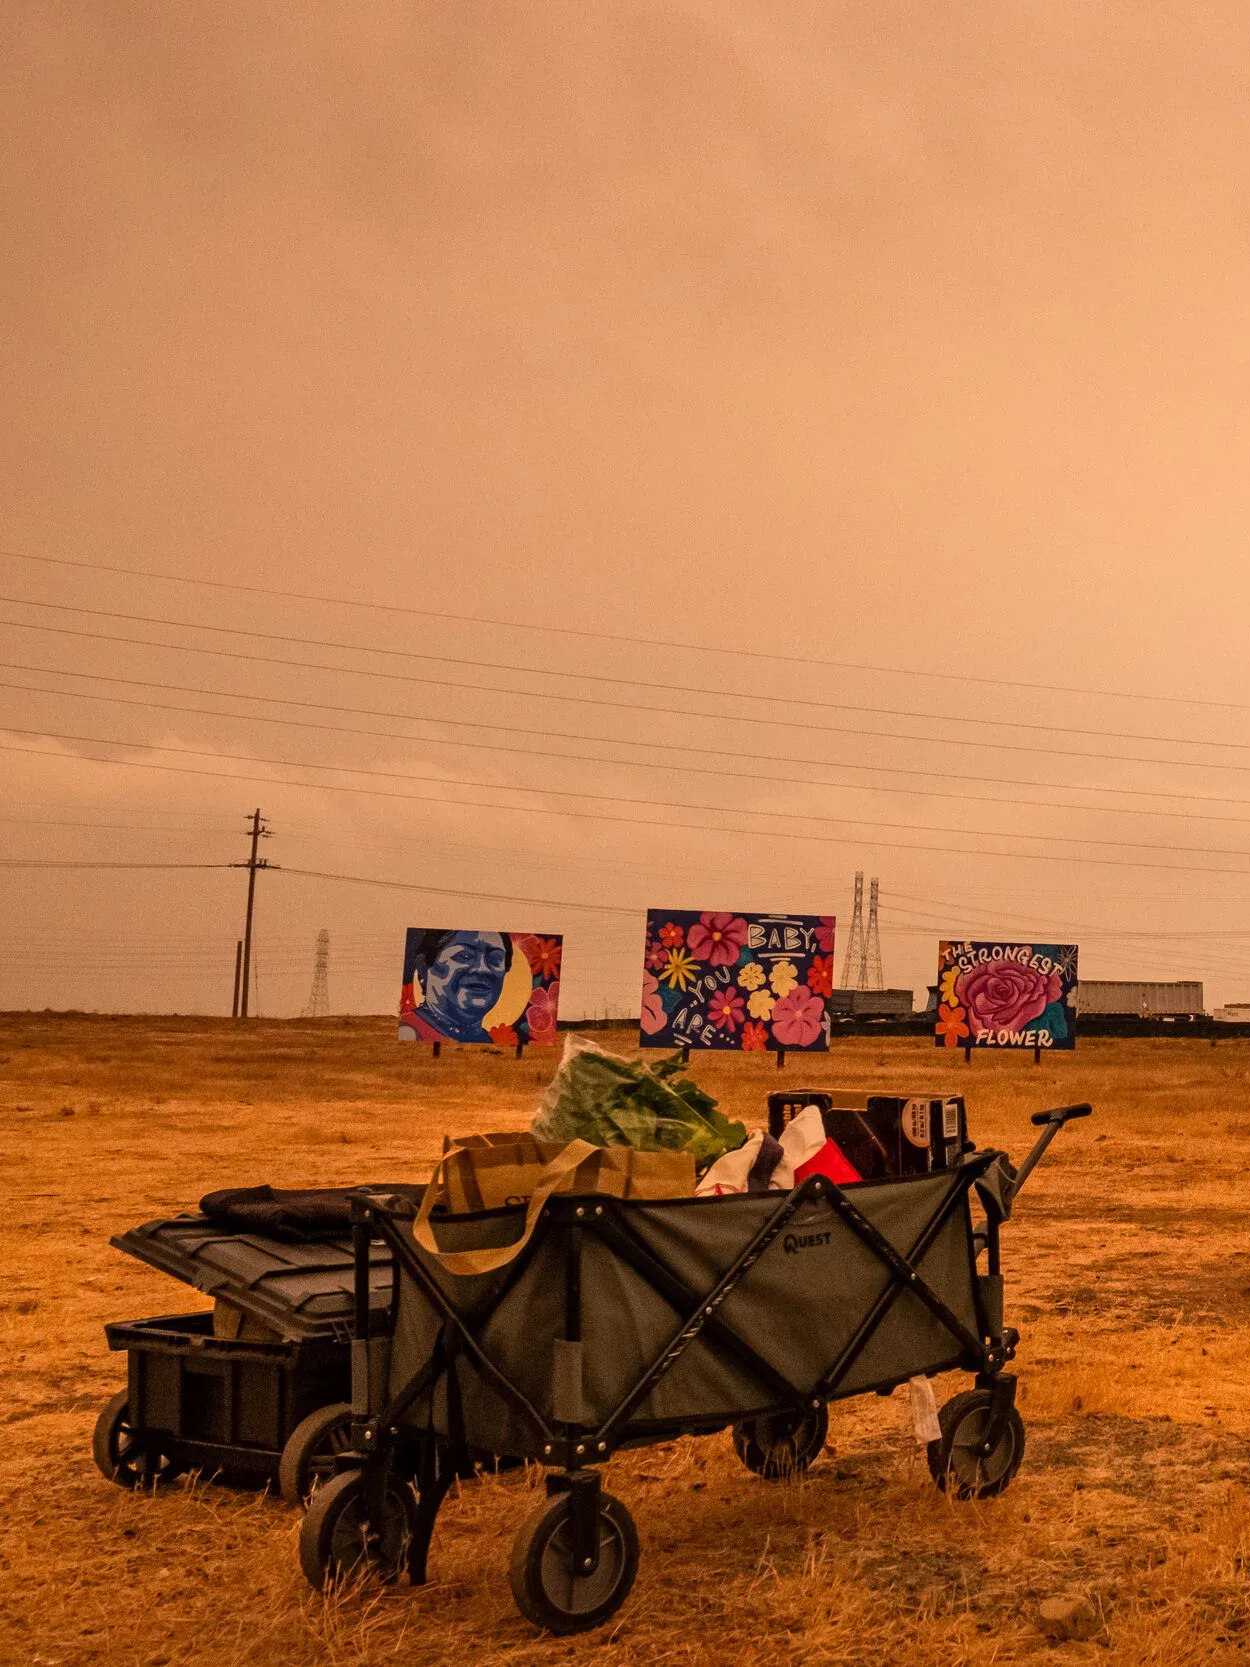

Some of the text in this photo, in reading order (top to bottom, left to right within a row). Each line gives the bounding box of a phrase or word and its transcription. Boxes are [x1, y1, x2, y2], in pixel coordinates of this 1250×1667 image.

[748, 924, 817, 953] BABY,
[942, 942, 974, 961] THE
[958, 945, 1064, 977] STRONGEST
[687, 966, 731, 1003] YOU
[975, 1029, 1054, 1047] FLOWER
[783, 1232, 831, 1255] QUEST
